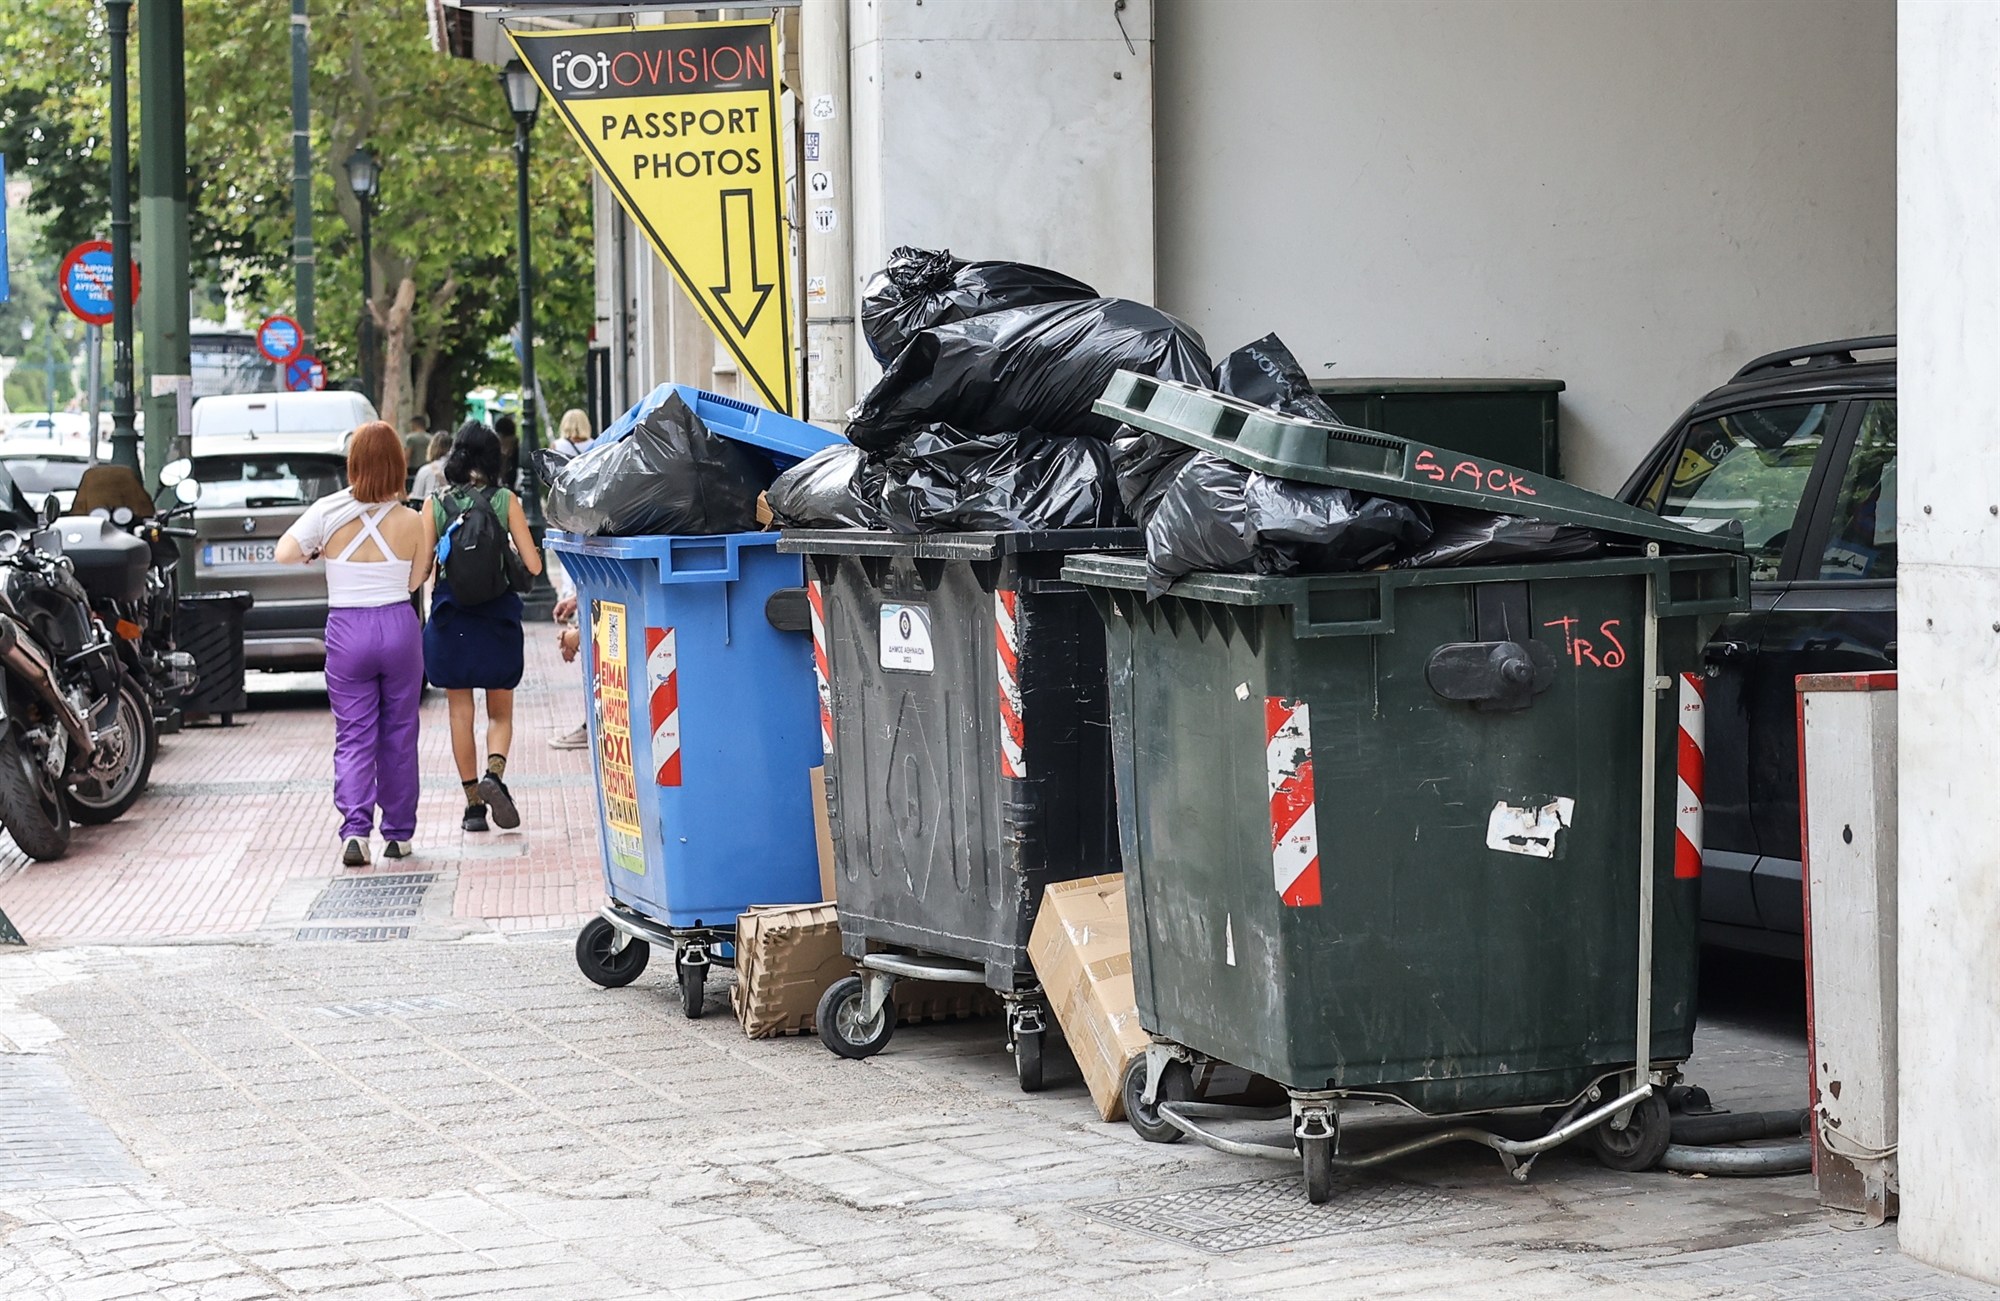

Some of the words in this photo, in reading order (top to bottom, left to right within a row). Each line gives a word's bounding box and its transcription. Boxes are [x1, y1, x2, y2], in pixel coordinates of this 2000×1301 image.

[602, 107, 759, 141] PASSPORT
[634, 148, 761, 180] PHOTOS
[1415, 450, 1537, 496] SACK
[256, 546, 275, 560] 63
[602, 660, 627, 691] ΕΙΜΑΙ
[606, 732, 632, 766] ΟΧΙ
